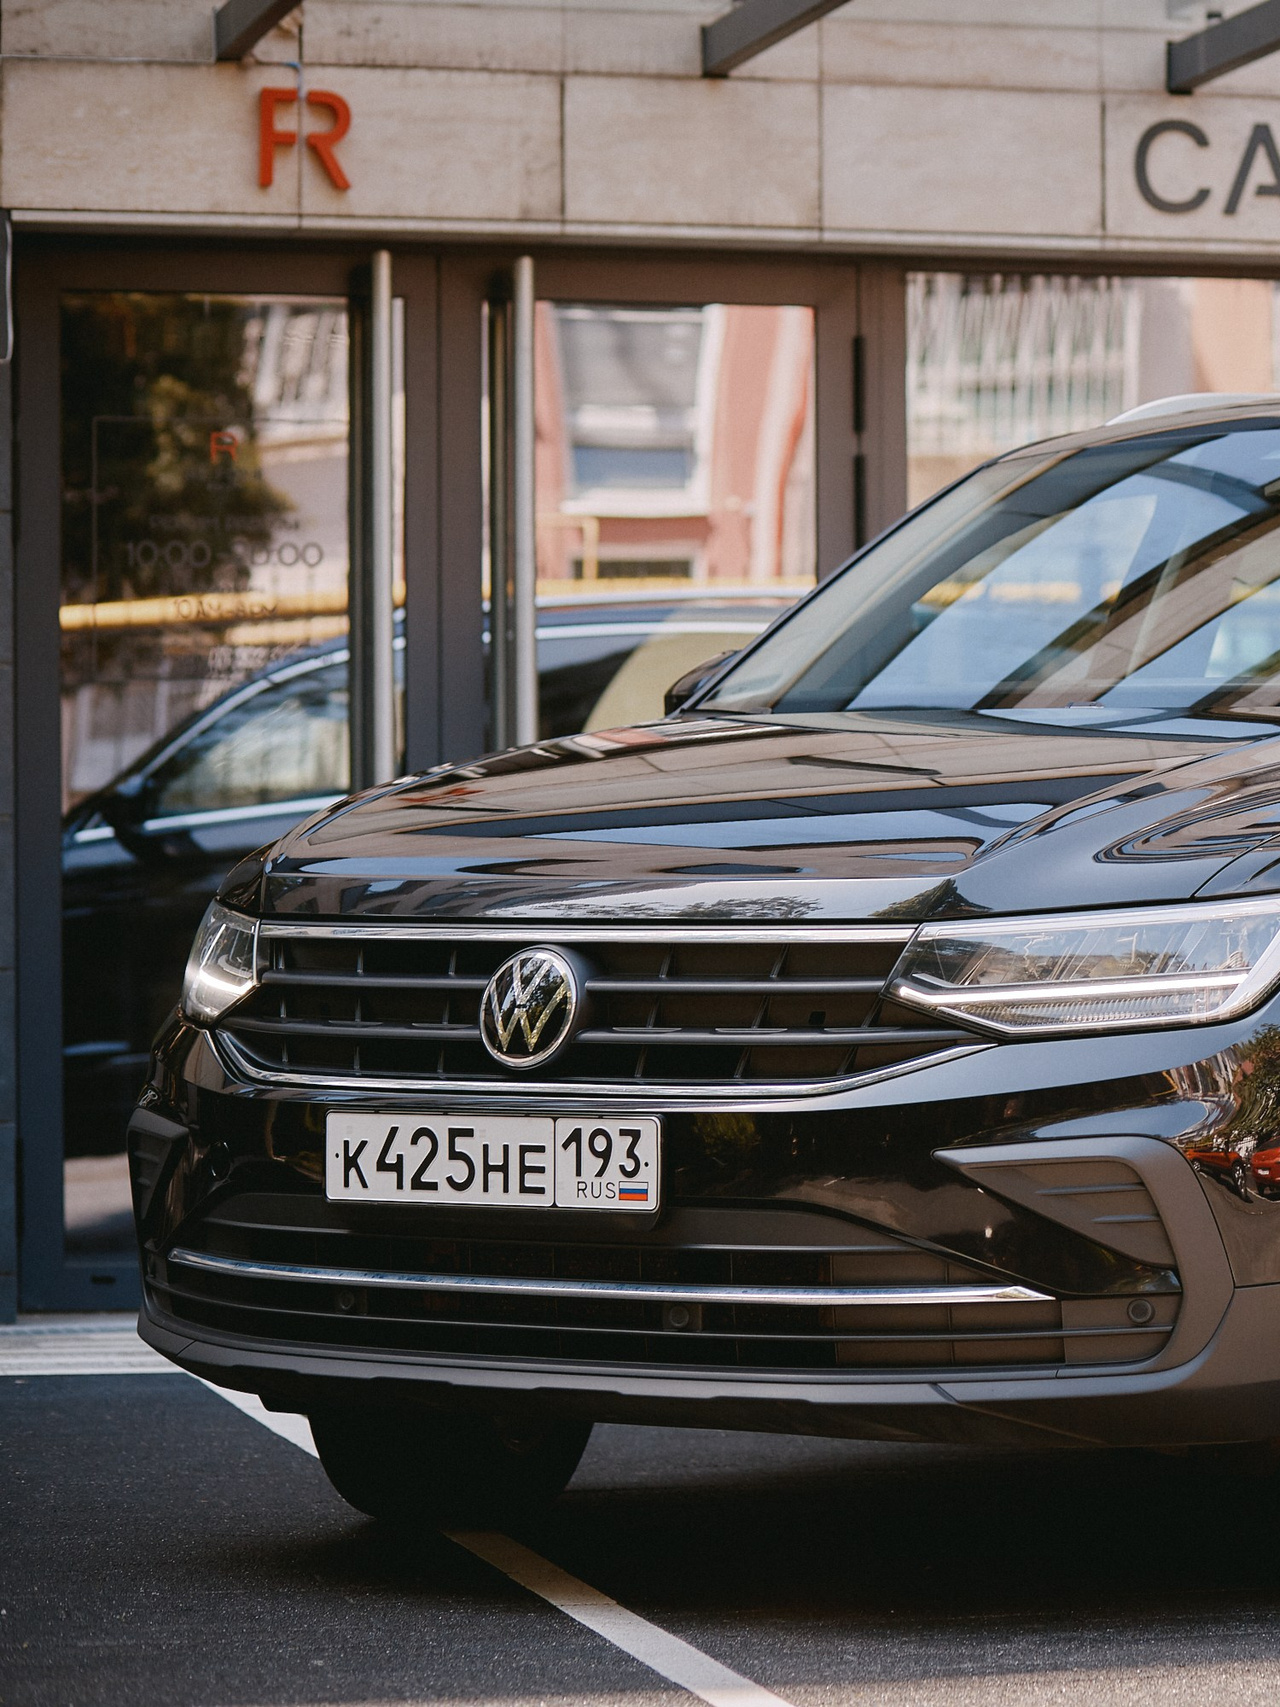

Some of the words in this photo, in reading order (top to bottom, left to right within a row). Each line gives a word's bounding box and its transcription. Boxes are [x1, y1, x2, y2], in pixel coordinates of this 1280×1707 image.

[259, 87, 351, 190] FR
[562, 1127, 642, 1178] 193
[576, 1181, 616, 1199] RUS
